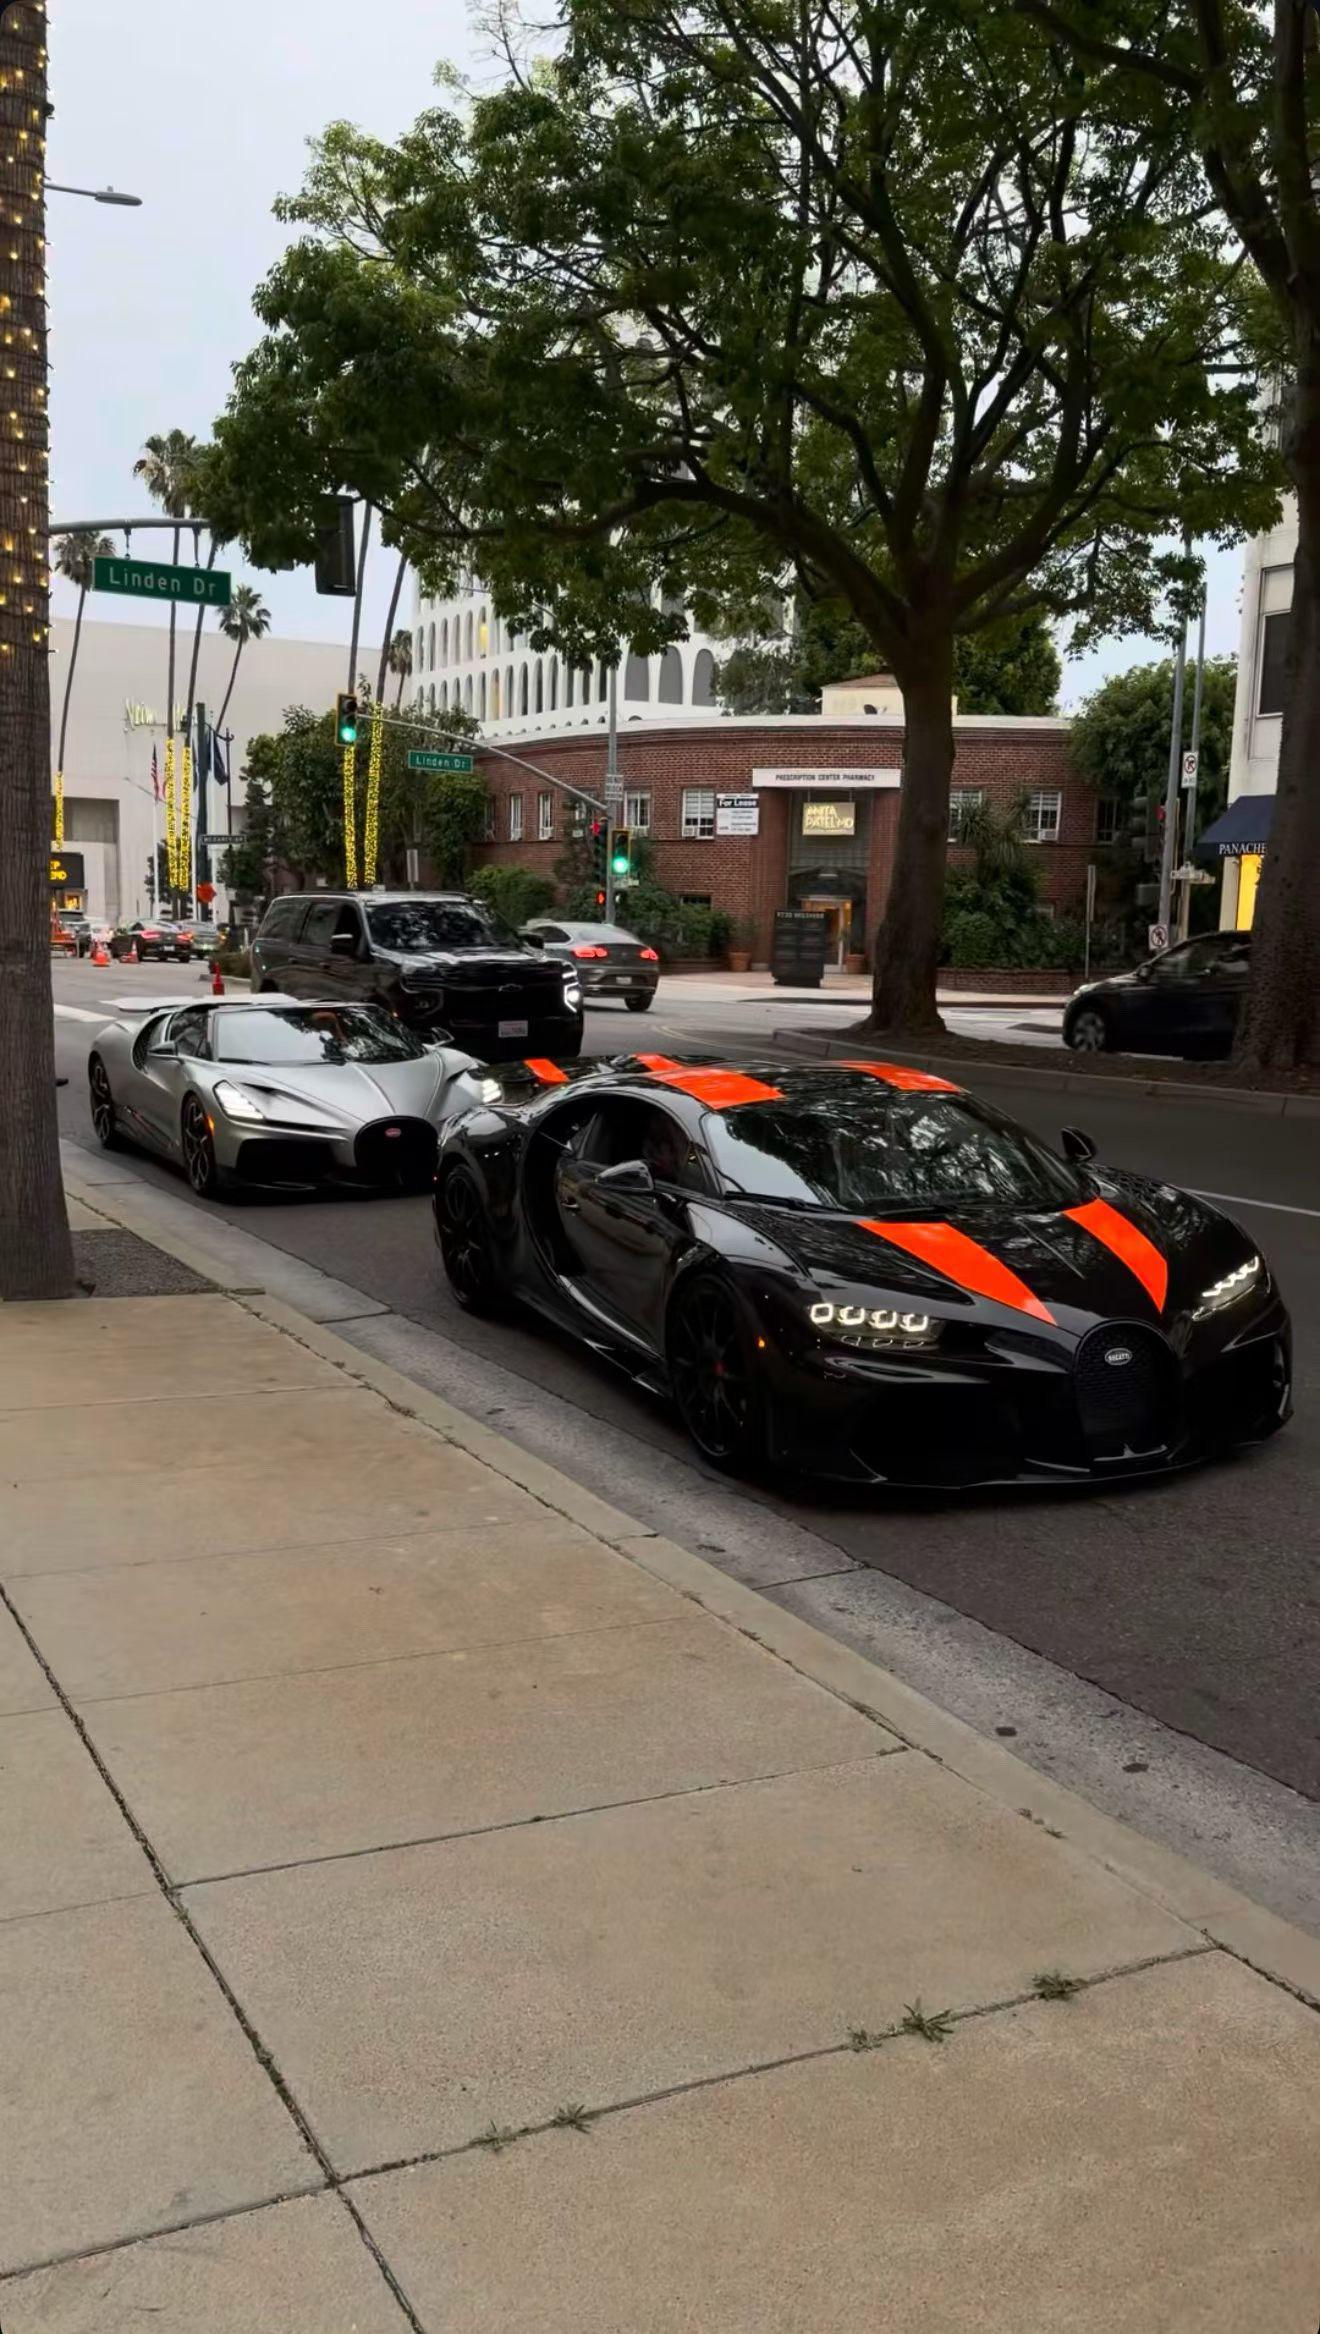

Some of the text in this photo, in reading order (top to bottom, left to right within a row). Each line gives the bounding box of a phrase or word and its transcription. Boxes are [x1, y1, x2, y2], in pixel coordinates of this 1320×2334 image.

[109, 566, 216, 597] Linden Dr
[416, 755, 466, 769] Linden Dr
[719, 799, 757, 807] For Lease
